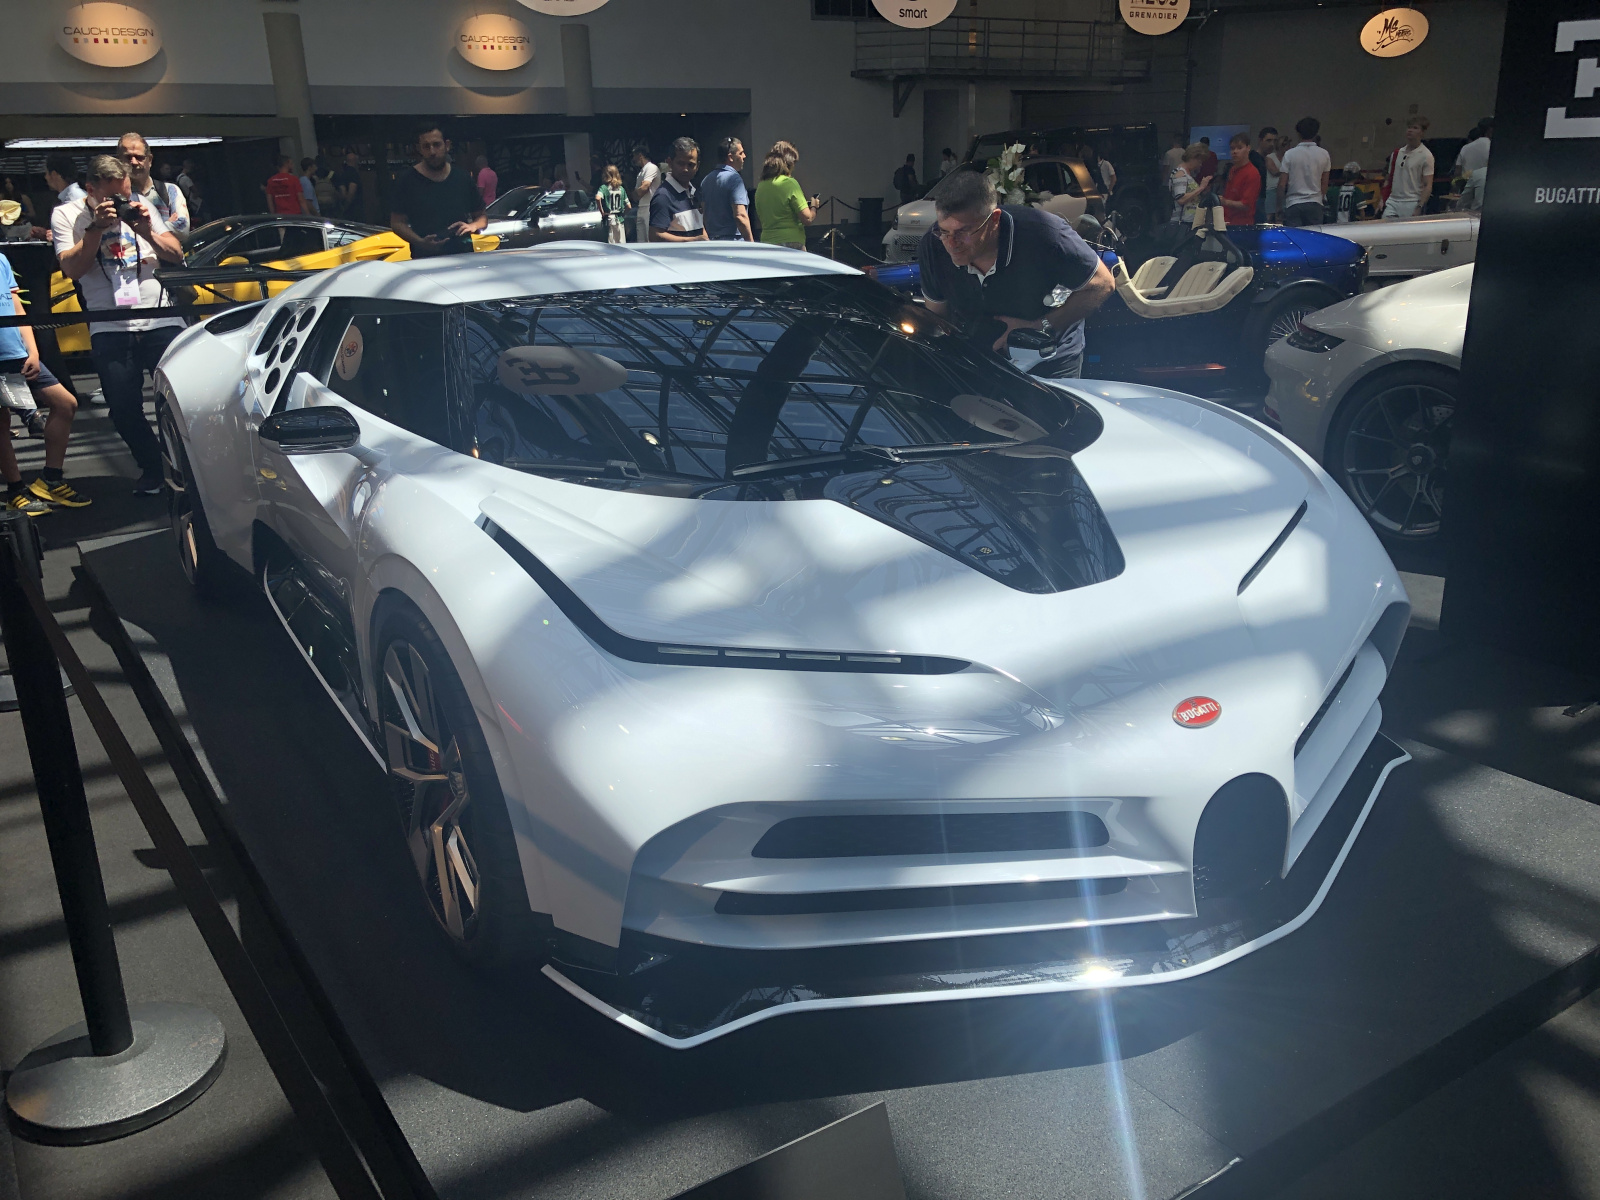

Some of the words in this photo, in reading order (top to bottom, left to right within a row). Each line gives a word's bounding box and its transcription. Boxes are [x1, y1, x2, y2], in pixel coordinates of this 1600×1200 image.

[899, 8, 928, 19] smart
[1129, 11, 1178, 20] GRENADIER
[63, 26, 109, 36] CAUCHI
[111, 27, 154, 37] DESIGN
[460, 34, 495, 43] CAUCHI
[497, 35, 530, 44] DESIGN
[610, 193, 621, 211] 10
[1535, 187, 1600, 204] BUGATTI
[1338, 194, 1350, 212] 10
[1179, 702, 1218, 722] BUGATTI
